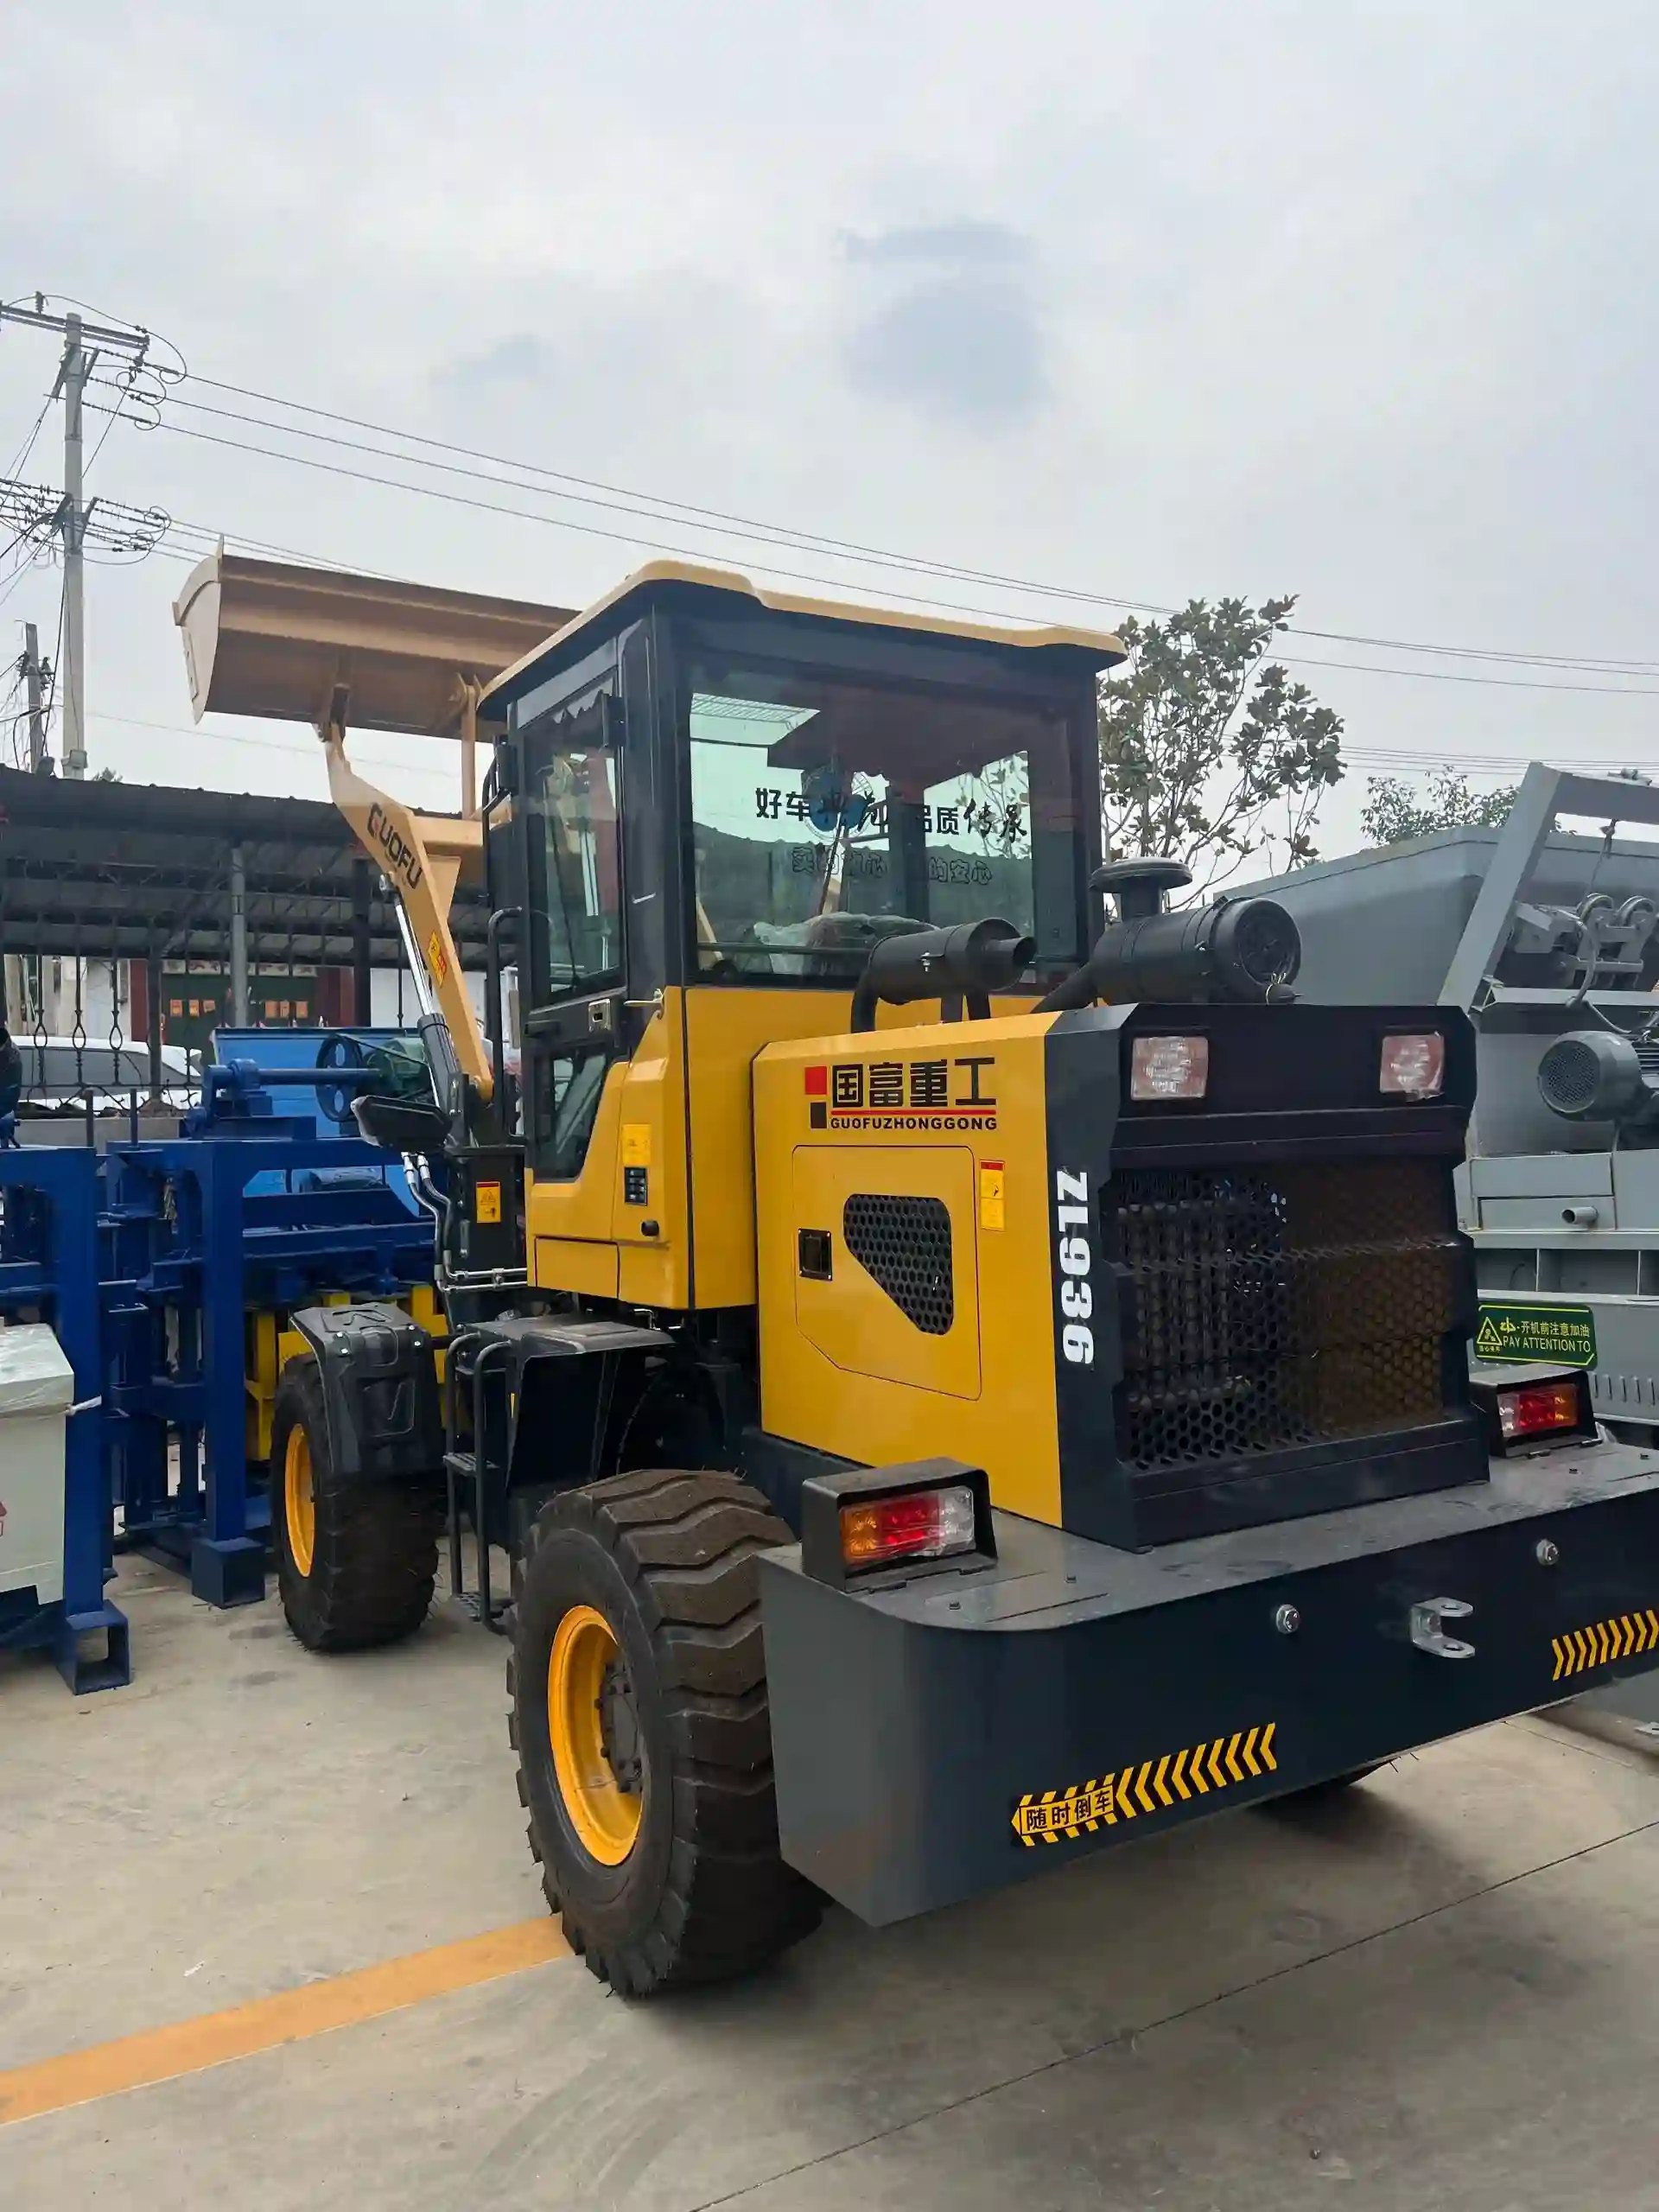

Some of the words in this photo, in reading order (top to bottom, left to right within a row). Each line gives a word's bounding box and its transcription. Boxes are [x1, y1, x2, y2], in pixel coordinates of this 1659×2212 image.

[831, 1057, 996, 1108] 国富重工
[830, 1116, 997, 1130] GUOFUZHONGGONG
[1056, 1166, 1094, 1365] ZL936
[1503, 1335, 1521, 1348] PAY
[1523, 1337, 1575, 1352] ATTENTION
[1577, 1340, 1591, 1353] TO
[1027, 1789, 1111, 1830] 随时倒车
